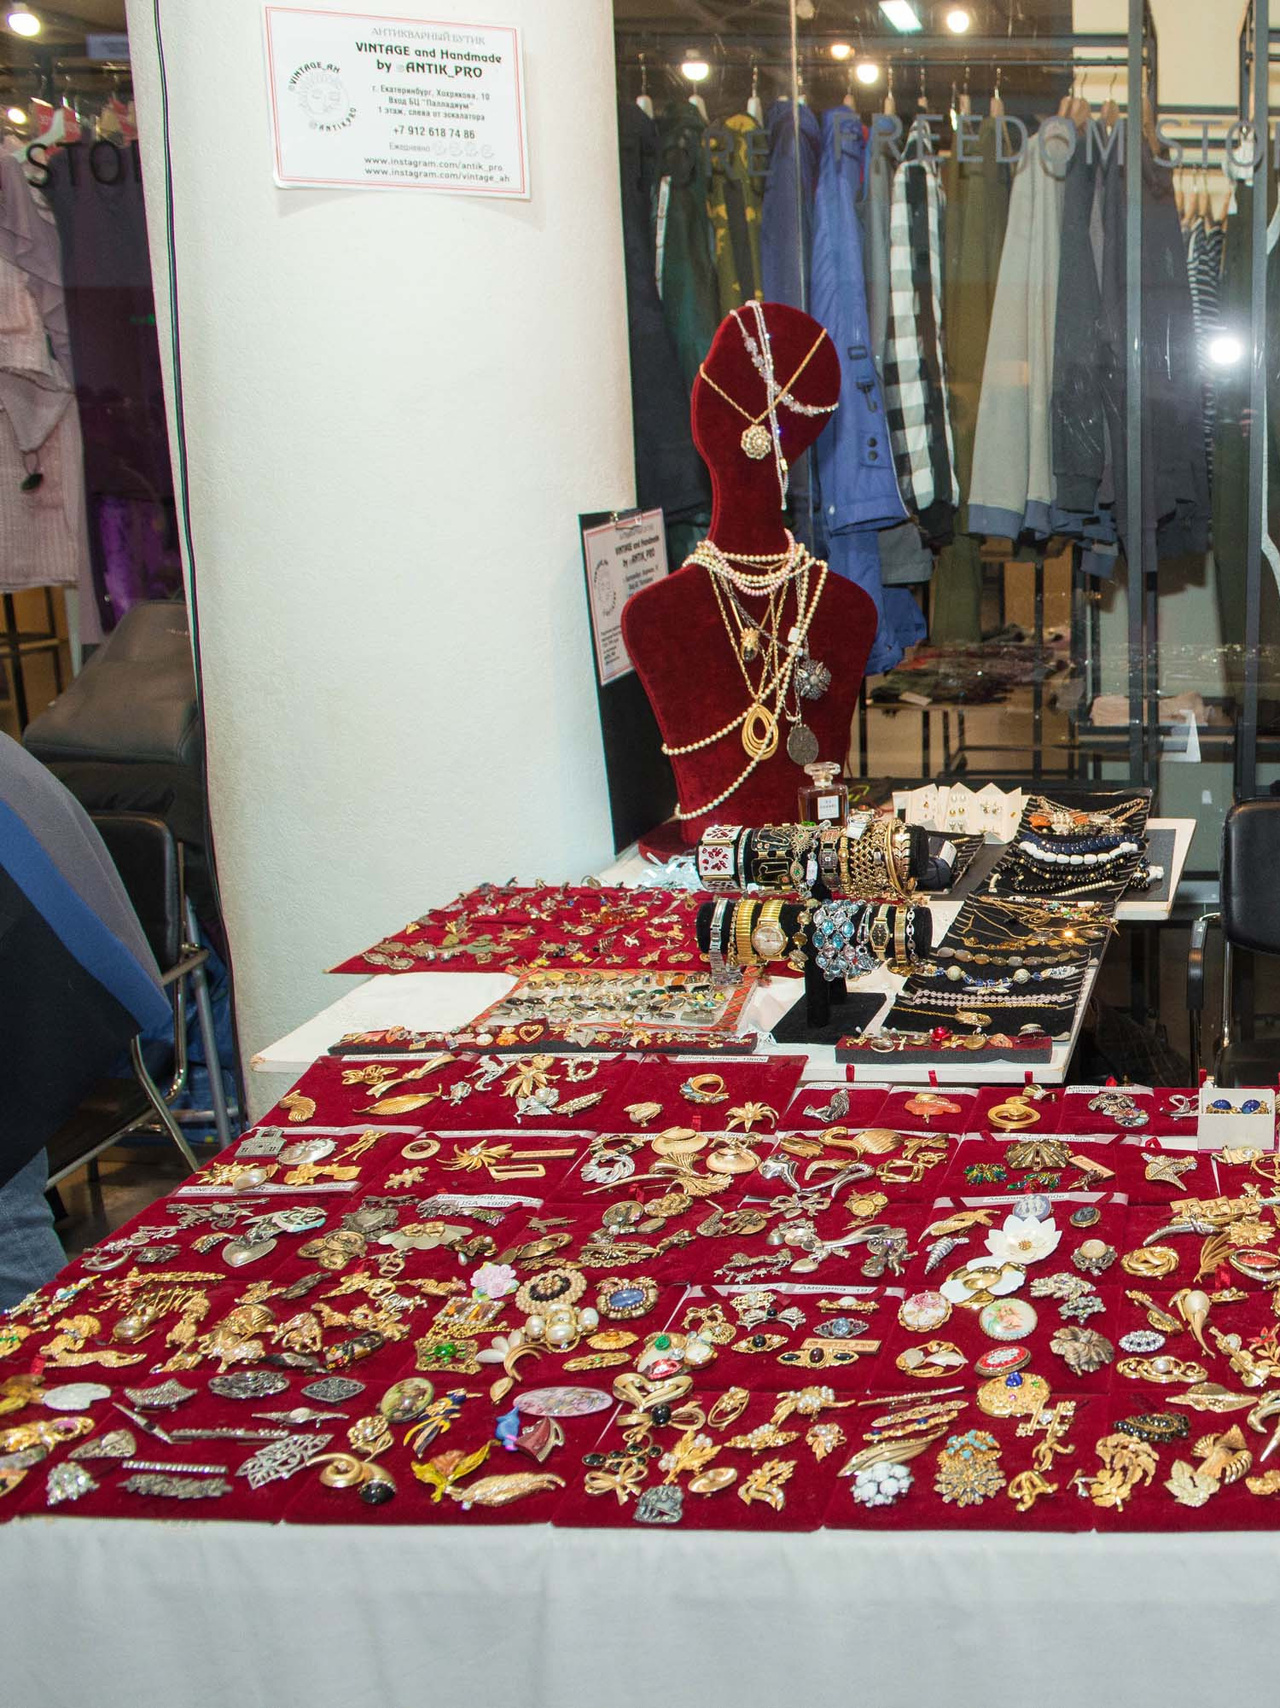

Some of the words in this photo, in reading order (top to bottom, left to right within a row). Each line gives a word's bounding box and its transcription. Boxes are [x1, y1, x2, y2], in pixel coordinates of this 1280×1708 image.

[355, 41, 410, 56] VINTAGE
[414, 48, 436, 59] and
[440, 48, 502, 64] Handmade
[376, 59, 392, 73] by
[408, 126, 426, 136] 912
[428, 127, 446, 138] 618
[449, 129, 461, 139] 74
[832, 112, 1125, 167] FREEDOM
